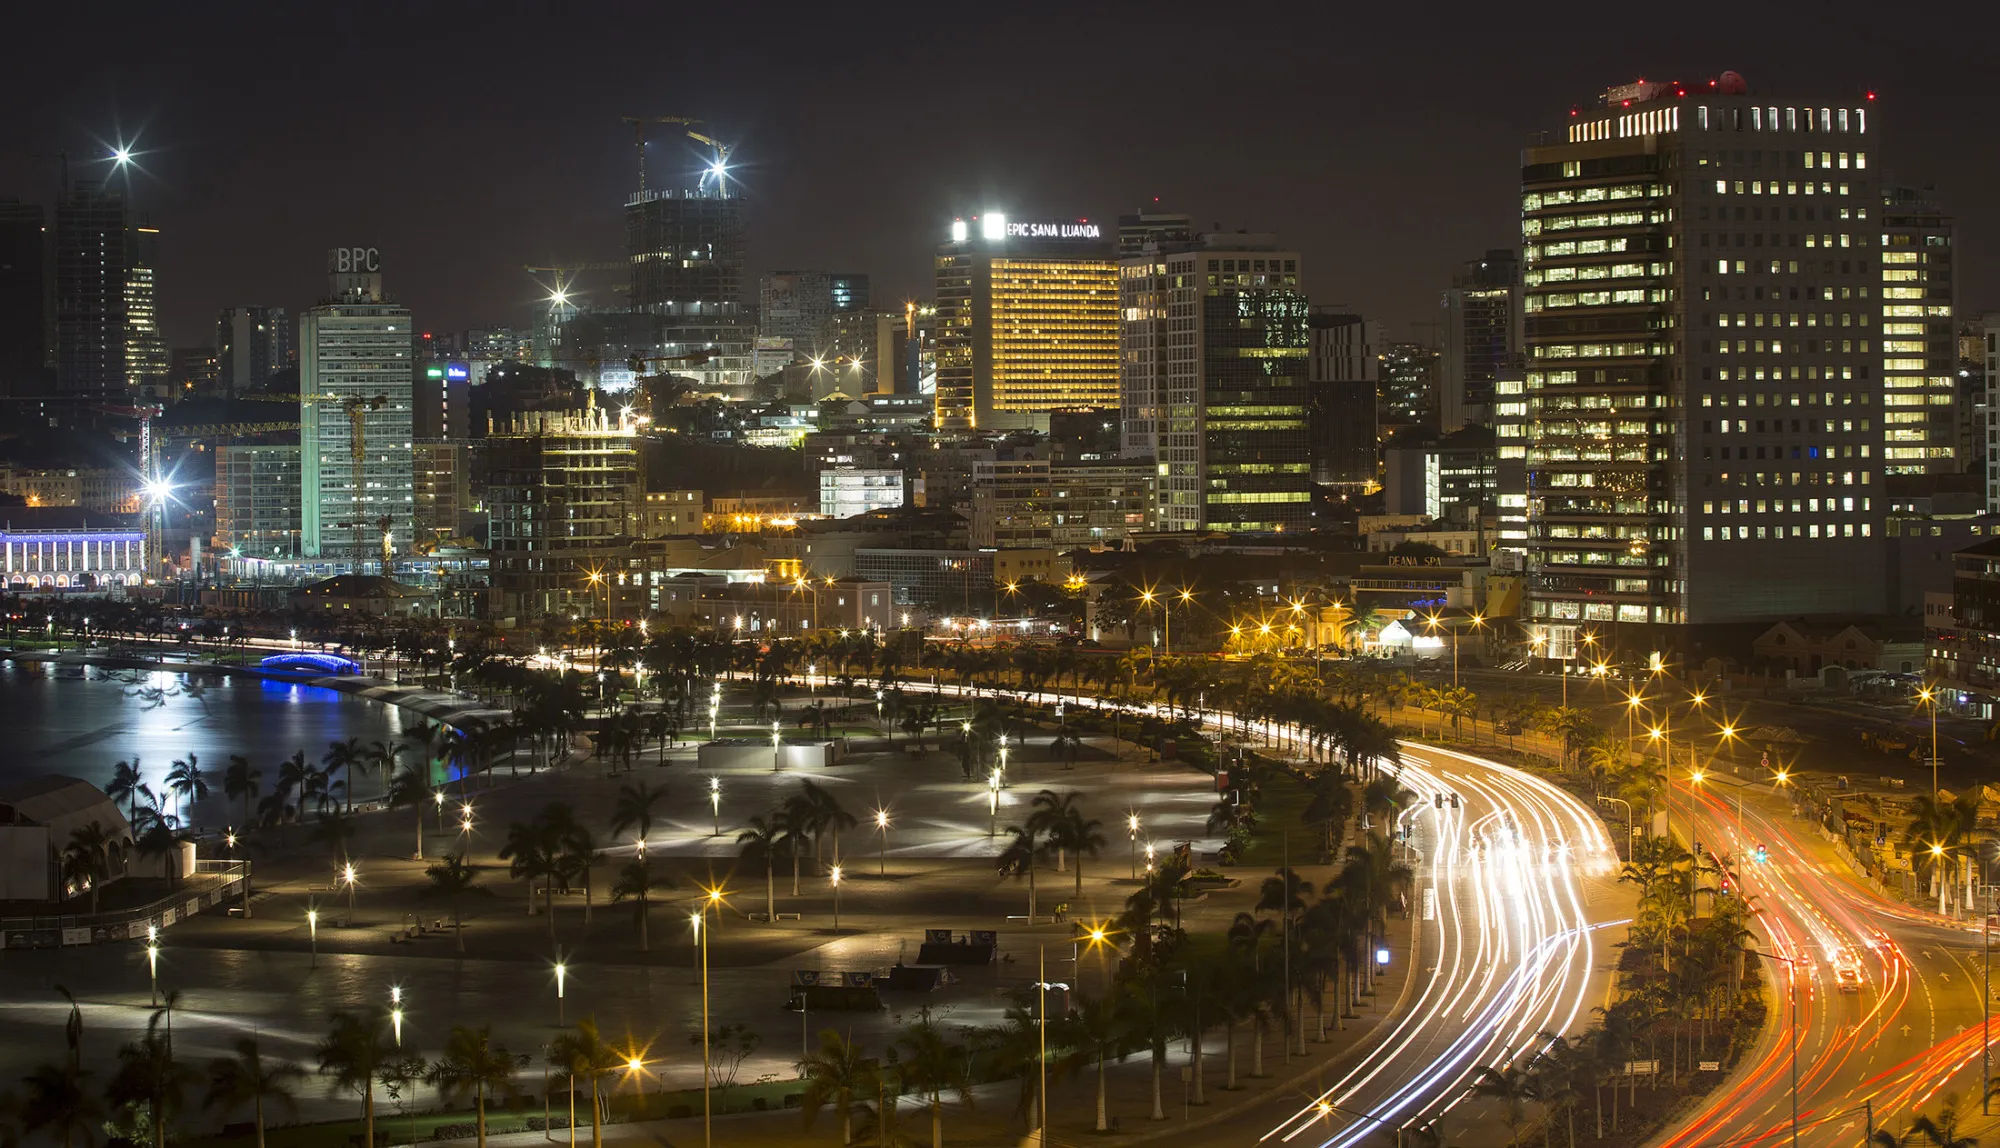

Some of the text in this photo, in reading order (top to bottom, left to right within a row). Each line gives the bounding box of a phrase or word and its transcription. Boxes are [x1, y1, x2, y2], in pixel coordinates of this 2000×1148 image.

[1007, 223, 1099, 237] EPIC SANA LUANDA
[337, 247, 379, 272] BPC
[1388, 555, 1442, 567] DEANA SPA
